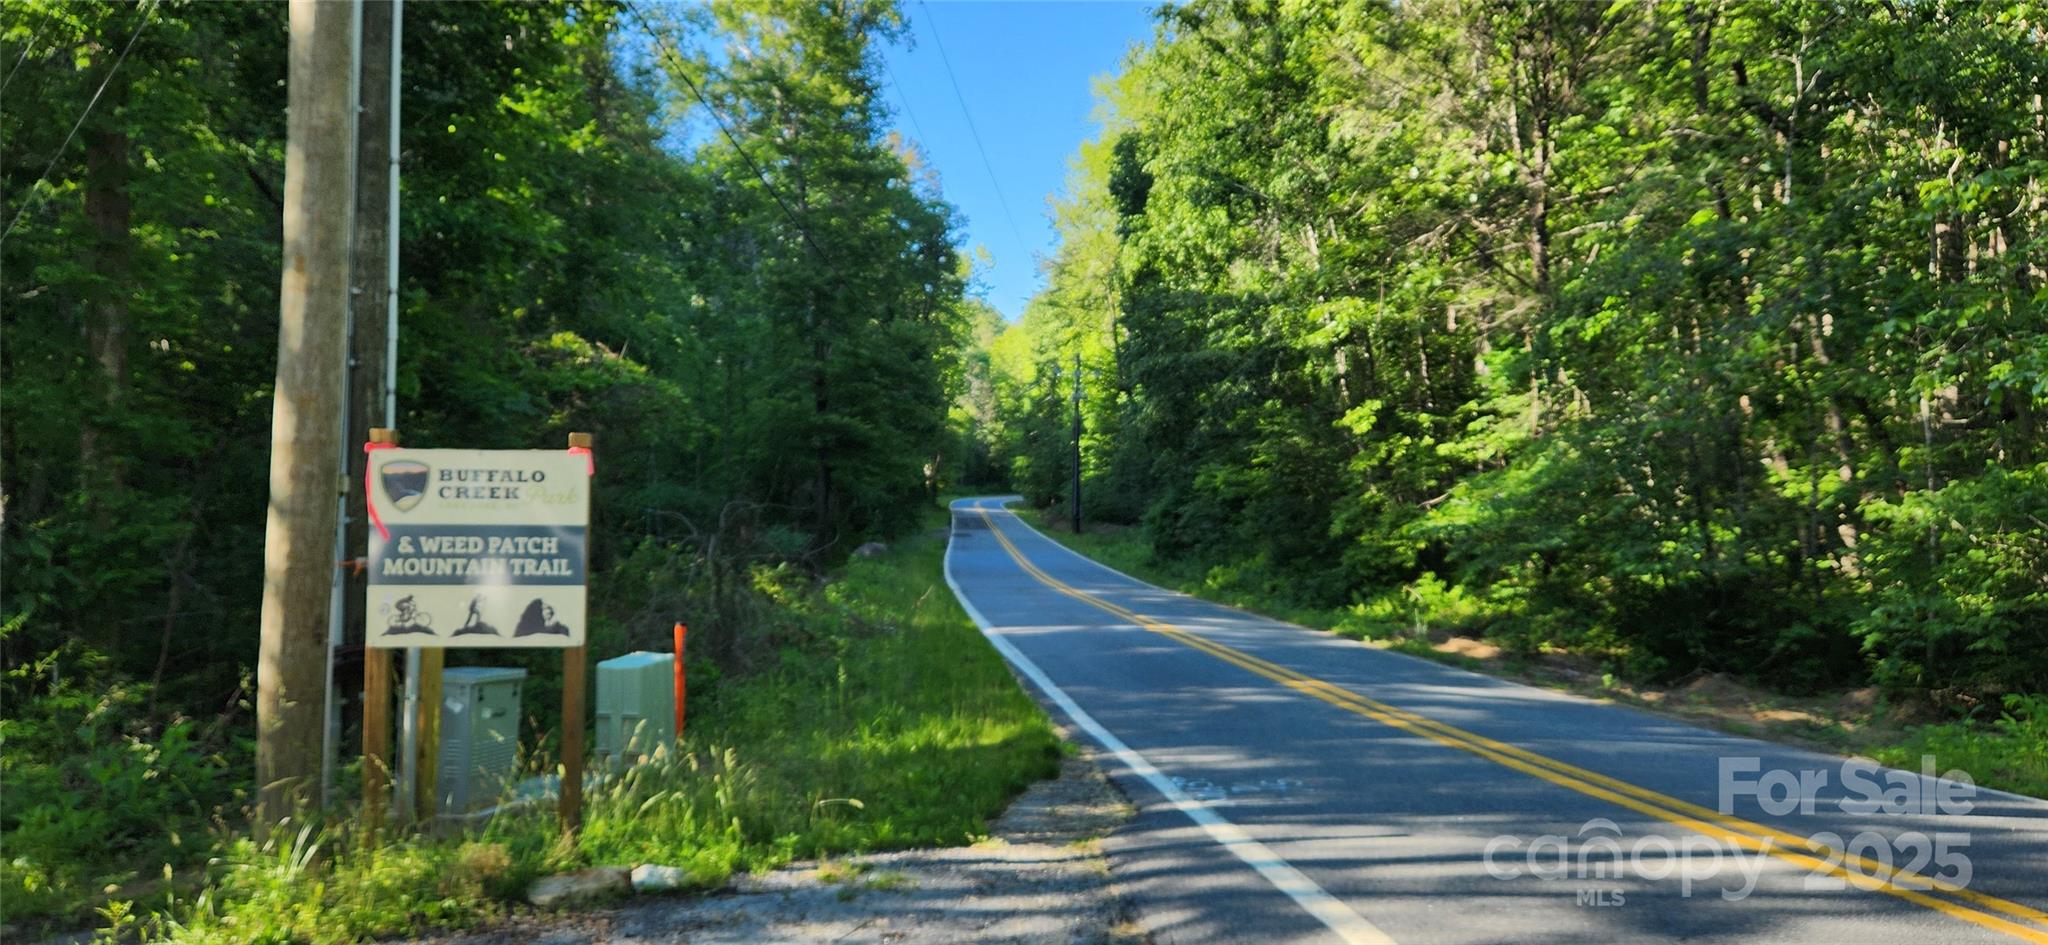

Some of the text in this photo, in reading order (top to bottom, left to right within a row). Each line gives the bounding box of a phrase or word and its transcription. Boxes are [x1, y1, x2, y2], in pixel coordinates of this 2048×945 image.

[439, 469, 546, 483] BUFFALO
[439, 487, 520, 500] CREEK
[398, 536, 559, 554] & WEED PATCH
[383, 558, 573, 577] MOUNTAIN TRAIL
